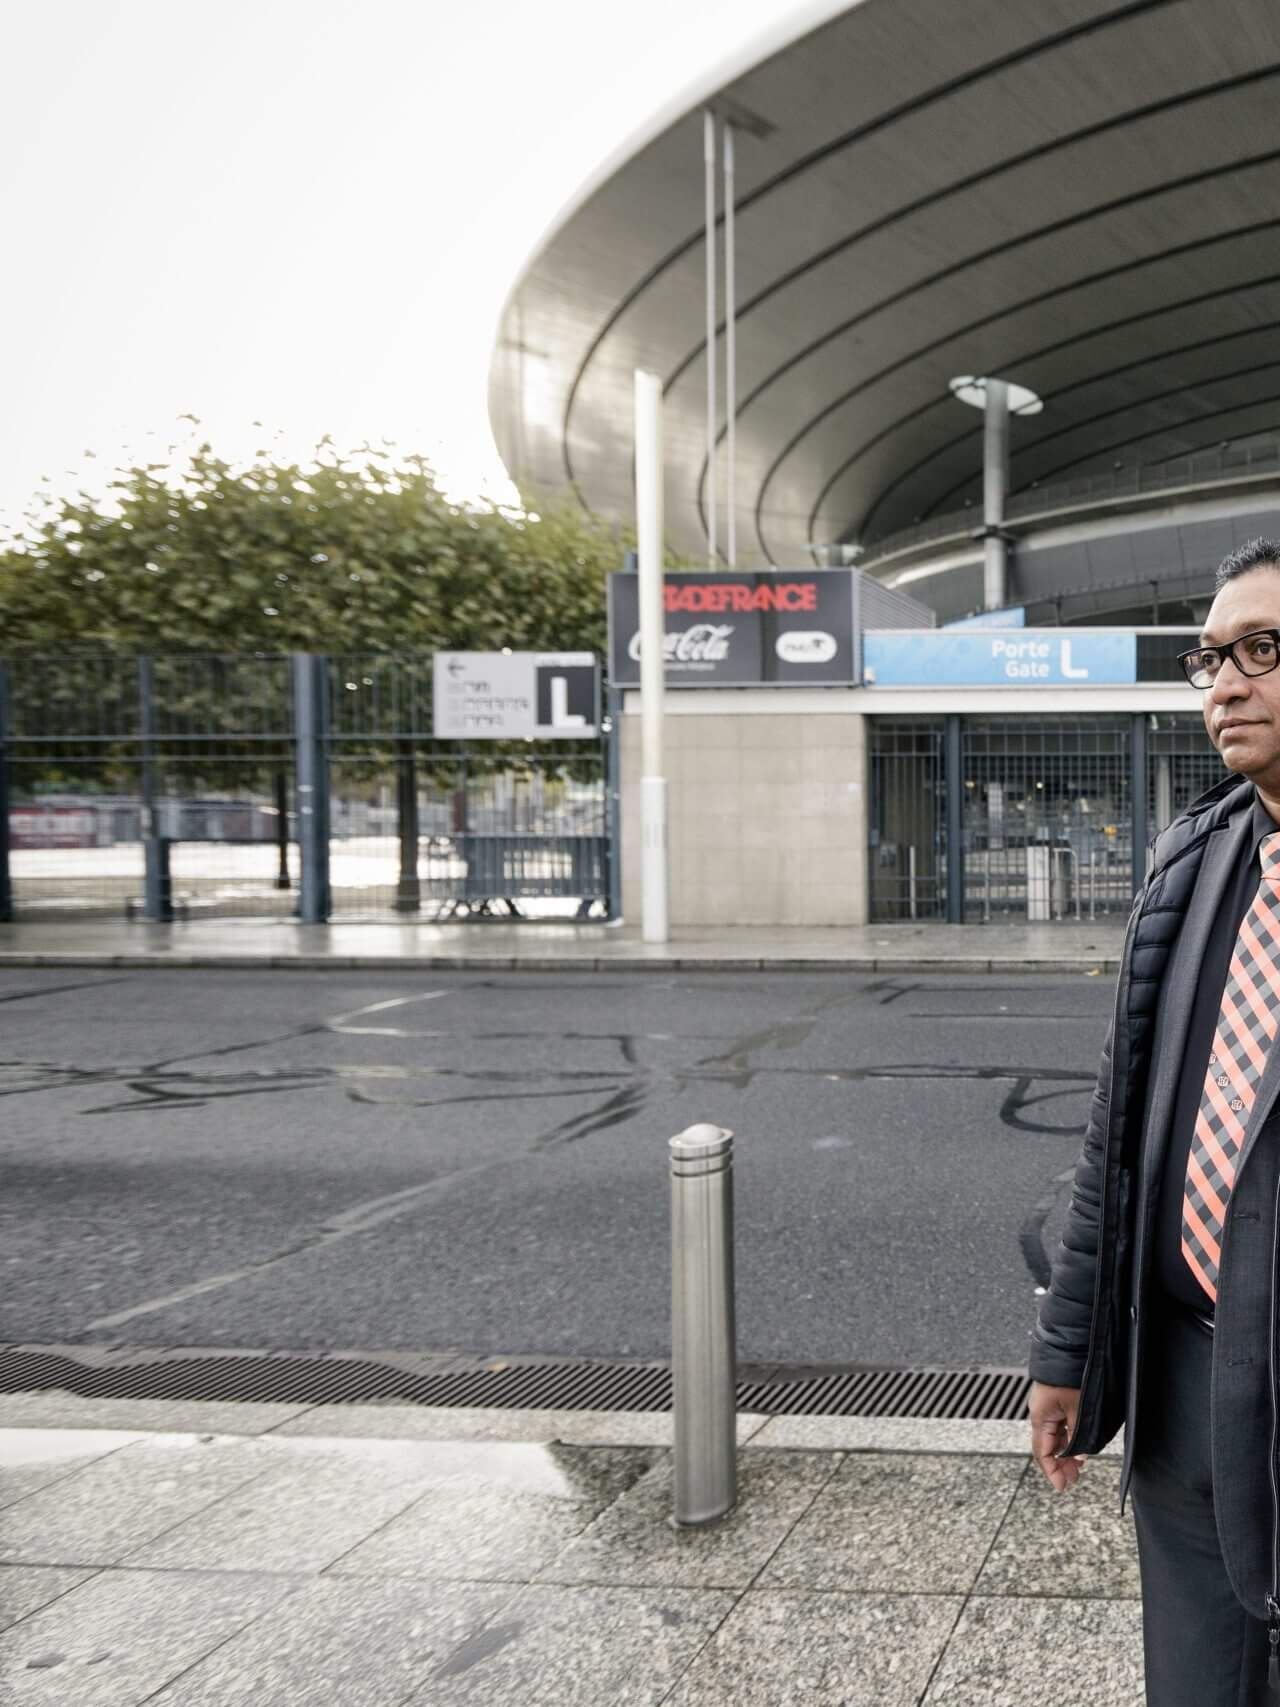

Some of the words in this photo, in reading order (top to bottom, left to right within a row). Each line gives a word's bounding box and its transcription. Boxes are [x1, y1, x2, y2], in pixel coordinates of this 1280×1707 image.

[992, 640, 1050, 658] Porte
[1060, 640, 1089, 679] L
[1005, 660, 1050, 678] Gate
[551, 677, 586, 727] L
